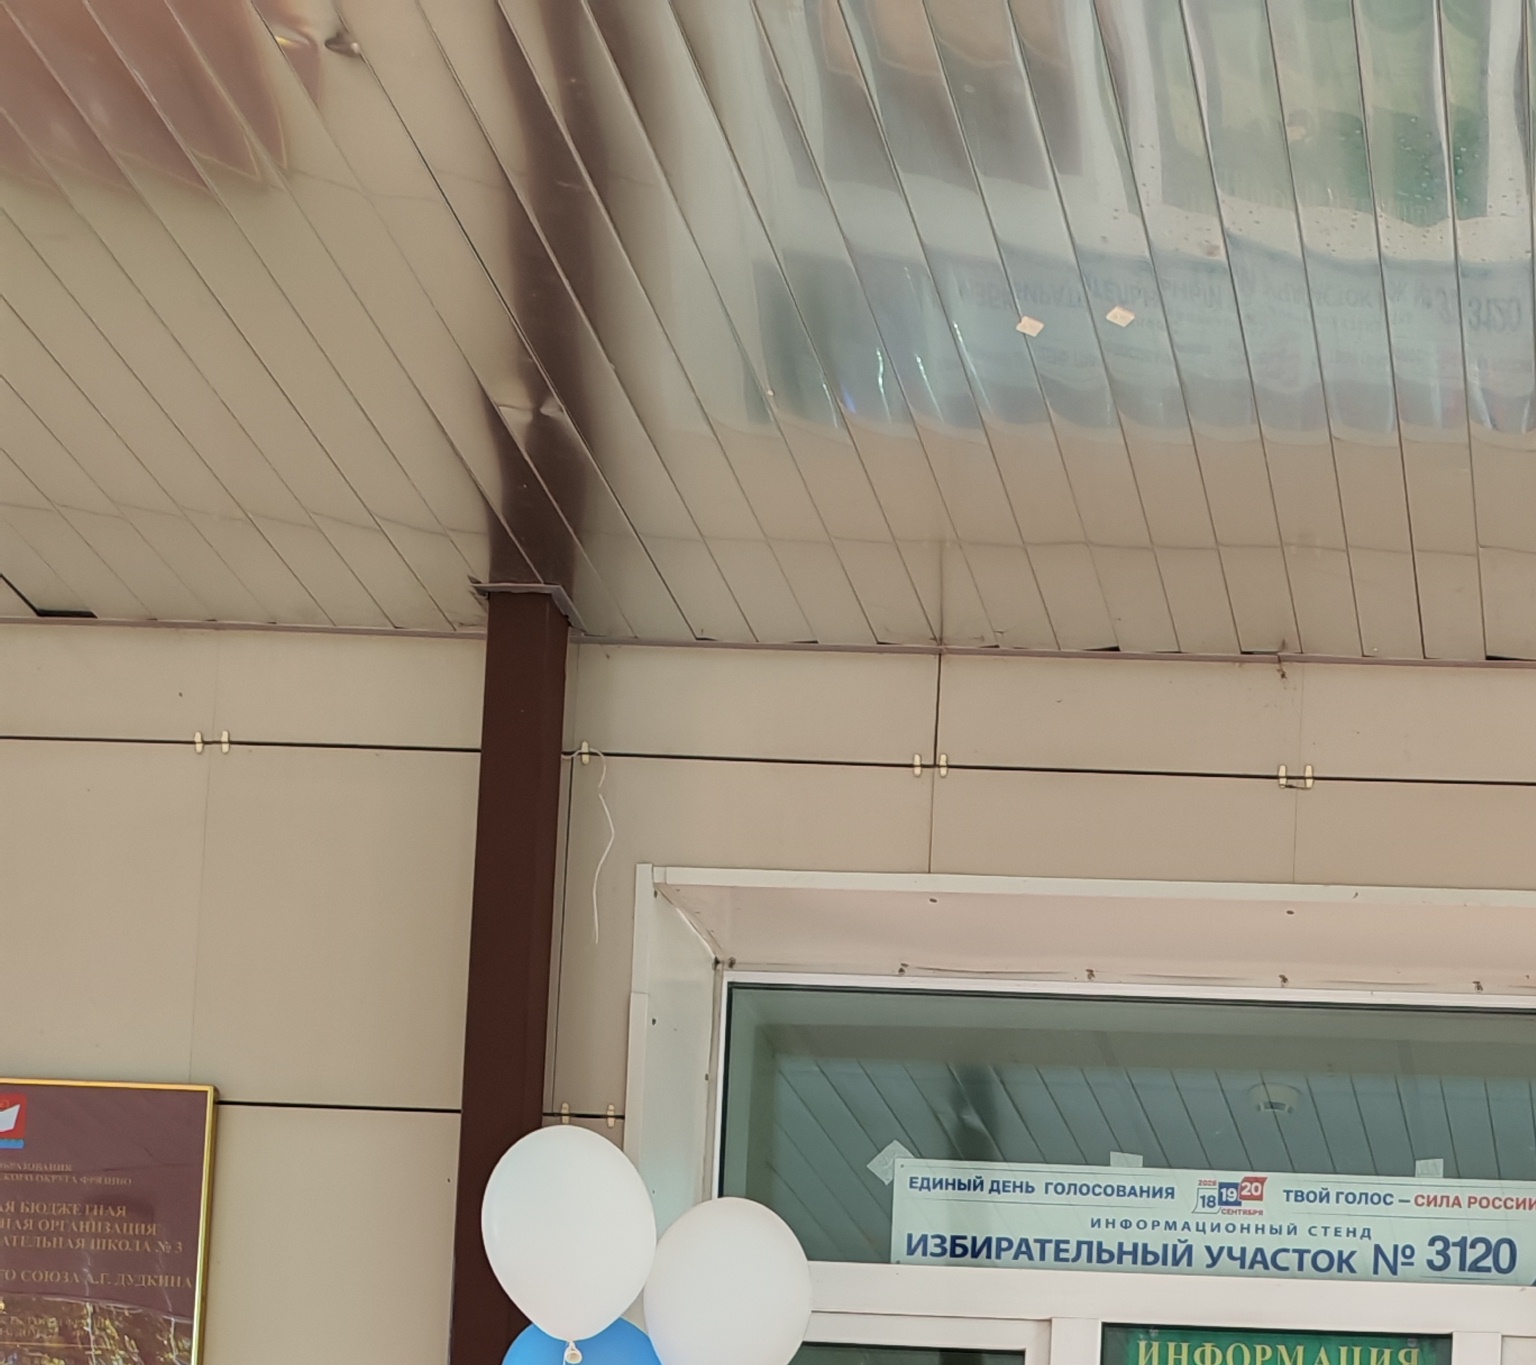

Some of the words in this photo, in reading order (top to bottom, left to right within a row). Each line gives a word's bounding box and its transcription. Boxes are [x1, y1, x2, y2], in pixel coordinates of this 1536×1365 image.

[908, 1176, 984, 1193] ЕДИНЫЙ
[988, 1178, 1035, 1195] ДЕНЬ
[1044, 1181, 1176, 1200] ГОЛОСОВАНИЯ
[1220, 1187, 1238, 1202] 19
[1240, 1181, 1262, 1196] 20
[1200, 1194, 1217, 1208] 18
[1283, 1186, 1330, 1205] ТВОЙ
[1335, 1190, 1395, 1207] ГОЛОС
[1414, 1193, 1463, 1209] СИЛА
[20, 1202, 127, 1218] БЮДЖЕТНАЯ
[38, 1219, 157, 1236] ОРГАНИЗАЦИЯ
[1090, 1217, 1298, 1236] ИНФОРМАЦИОННЫЙ
[1307, 1224, 1373, 1241] СТЕНД
[905, 1232, 1194, 1268] ИЗБИРАТЕЛЬНЫЙ
[1204, 1244, 1358, 1275] УЧАСТОК
[1372, 1243, 1416, 1276] №
[1426, 1234, 1518, 1275] 3120
[20, 1269, 80, 1283] СОЮЗА
